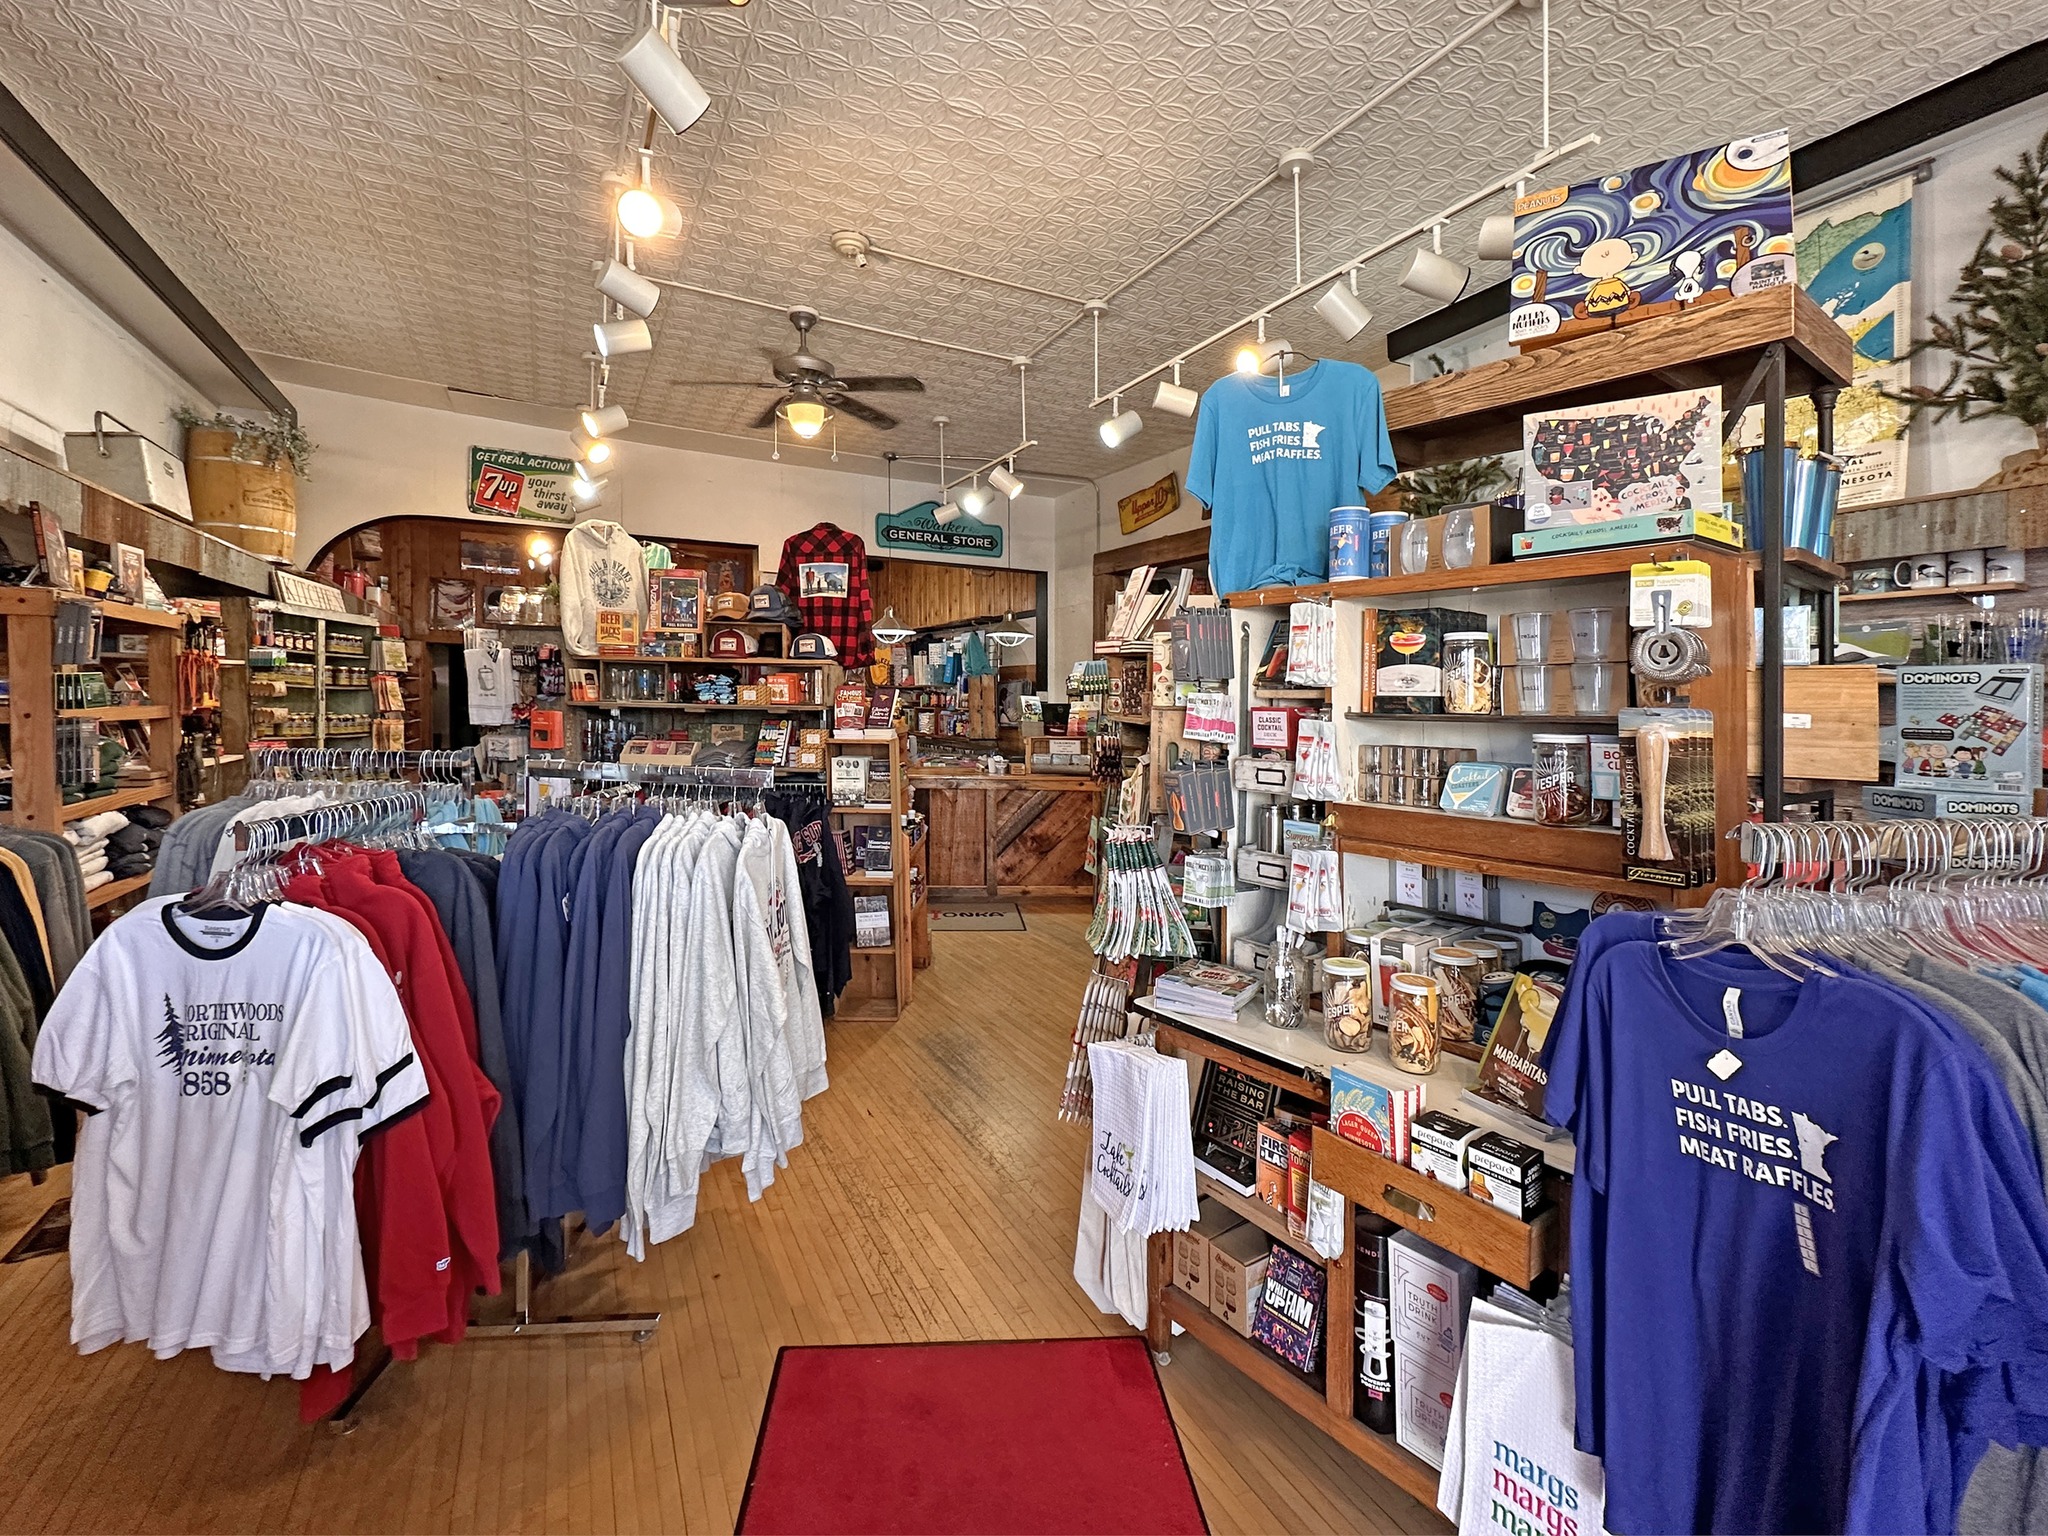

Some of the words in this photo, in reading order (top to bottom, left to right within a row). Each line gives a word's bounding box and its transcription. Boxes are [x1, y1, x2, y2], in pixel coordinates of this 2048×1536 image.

[1517, 193, 1562, 212] PEANUTS
[1247, 424, 1271, 438] PULL
[1272, 421, 1301, 432] TABS.
[1249, 438, 1270, 452] FISH
[1272, 434, 1302, 446] FRIES.
[476, 451, 498, 462] GET
[498, 454, 525, 466] REAL
[527, 458, 570, 472] ACTION!
[1251, 450, 1275, 465] MEAT
[1276, 447, 1322, 459] RAFFLES.
[527, 478, 556, 489] your
[1841, 471, 1893, 485] NESOTA
[533, 488, 567, 502] thirst
[1621, 478, 1674, 500] COCKTAILS
[1634, 488, 1669, 503] ACROSS
[536, 499, 568, 514] away
[1629, 495, 1673, 513] AMERICA
[1609, 523, 1639, 531] AMERICA
[888, 529, 949, 544] GENERAL
[952, 535, 992, 548] STORE
[281, 575, 345, 612] KITCHEN
[600, 613, 620, 625] BEER
[600, 626, 620, 636] HACKS
[1902, 672, 1981, 684] DOMINOTS
[1450, 766, 1489, 784] Cocktail
[1873, 793, 1925, 811] DOMINOTS
[1948, 802, 2019, 815] DOMINOTS
[185, 1002, 284, 1022] ORTHWOODS
[186, 1022, 260, 1041] RIGINAL
[1493, 1043, 1549, 1086] MARGARITAS
[1218, 1074, 1265, 1099] RAISING
[1216, 1083, 1237, 1099] THE
[1240, 1094, 1264, 1111] BAR
[1671, 1078, 1722, 1111] PULL
[1723, 1092, 1789, 1129] TABS.
[1341, 1119, 1359, 1128] LAGER
[1360, 1124, 1379, 1141] QUEEN
[1417, 1129, 1454, 1150] prepara
[1675, 1106, 1722, 1139] FISH
[1727, 1121, 1798, 1160] FRIES.
[1100, 1130, 1125, 1166] Lake
[1261, 1135, 1289, 1156] FIRS
[1344, 1131, 1376, 1150] MINNESOTA
[1482, 1142, 1520, 1159] prepara
[1474, 1153, 1515, 1176] prepara
[1679, 1134, 1737, 1171] MEAT
[1742, 1154, 1836, 1213] RAFFLES.
[1215, 1253, 1236, 1273] Original
[1265, 1289, 1285, 1309] UP
[1267, 1276, 1288, 1299] WHAT
[1284, 1290, 1314, 1328] FAM
[1408, 1290, 1438, 1312] TRUTH
[1223, 1311, 1229, 1320] 4
[1408, 1303, 1437, 1324] DRINK
[1415, 1397, 1445, 1421] TRUTH
[1414, 1408, 1444, 1431] DRINK
[1493, 1440, 1579, 1511] margs
[1493, 1468, 1578, 1536] margs
